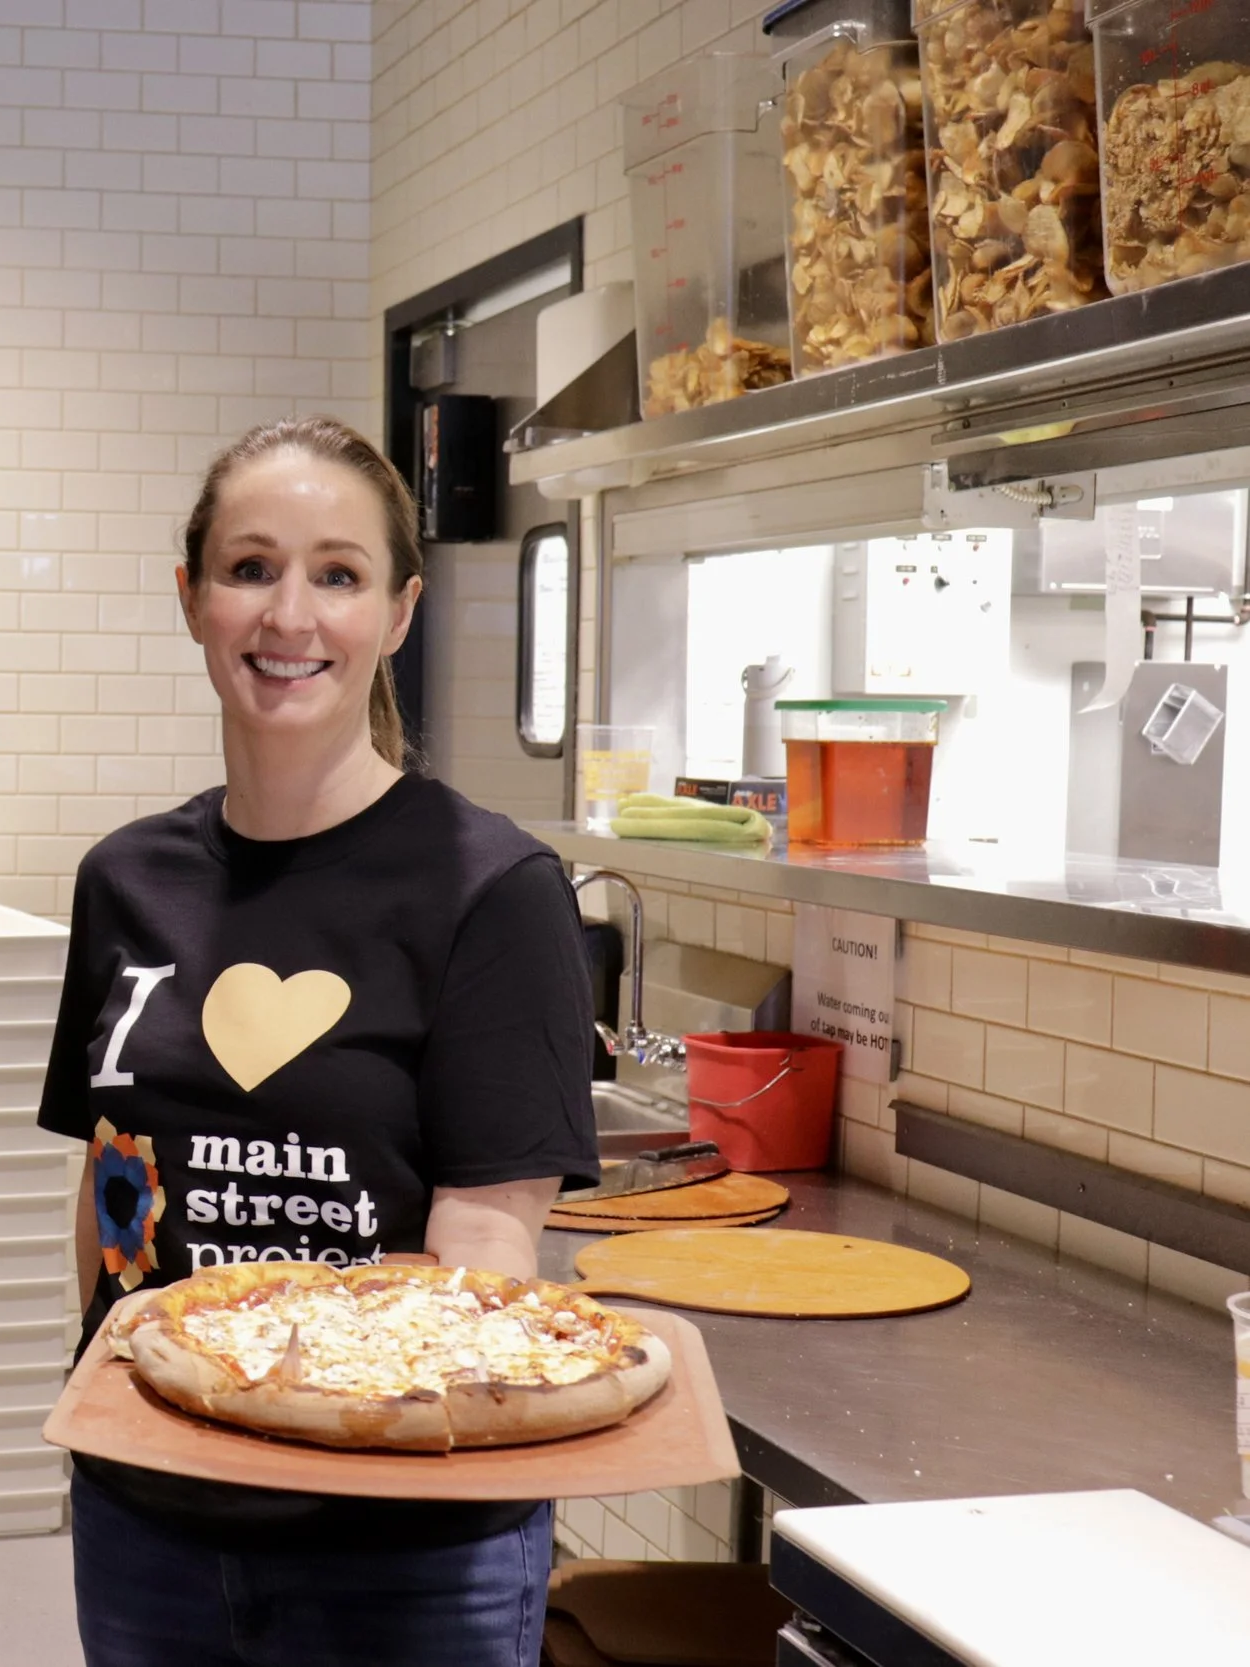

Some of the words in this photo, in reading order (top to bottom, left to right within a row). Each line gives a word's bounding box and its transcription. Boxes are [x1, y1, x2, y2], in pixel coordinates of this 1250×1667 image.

[731, 789, 778, 812] AXLE
[831, 937, 878, 960] CAUTION!
[817, 992, 842, 1010] Water
[843, 1002, 877, 1024] coming
[90, 963, 176, 1088] I
[810, 1017, 821, 1033] of
[822, 1021, 836, 1039] tap
[837, 1027, 855, 1046] may
[856, 1029, 868, 1047] be
[187, 1132, 350, 1182] main
[186, 1181, 378, 1238] street
